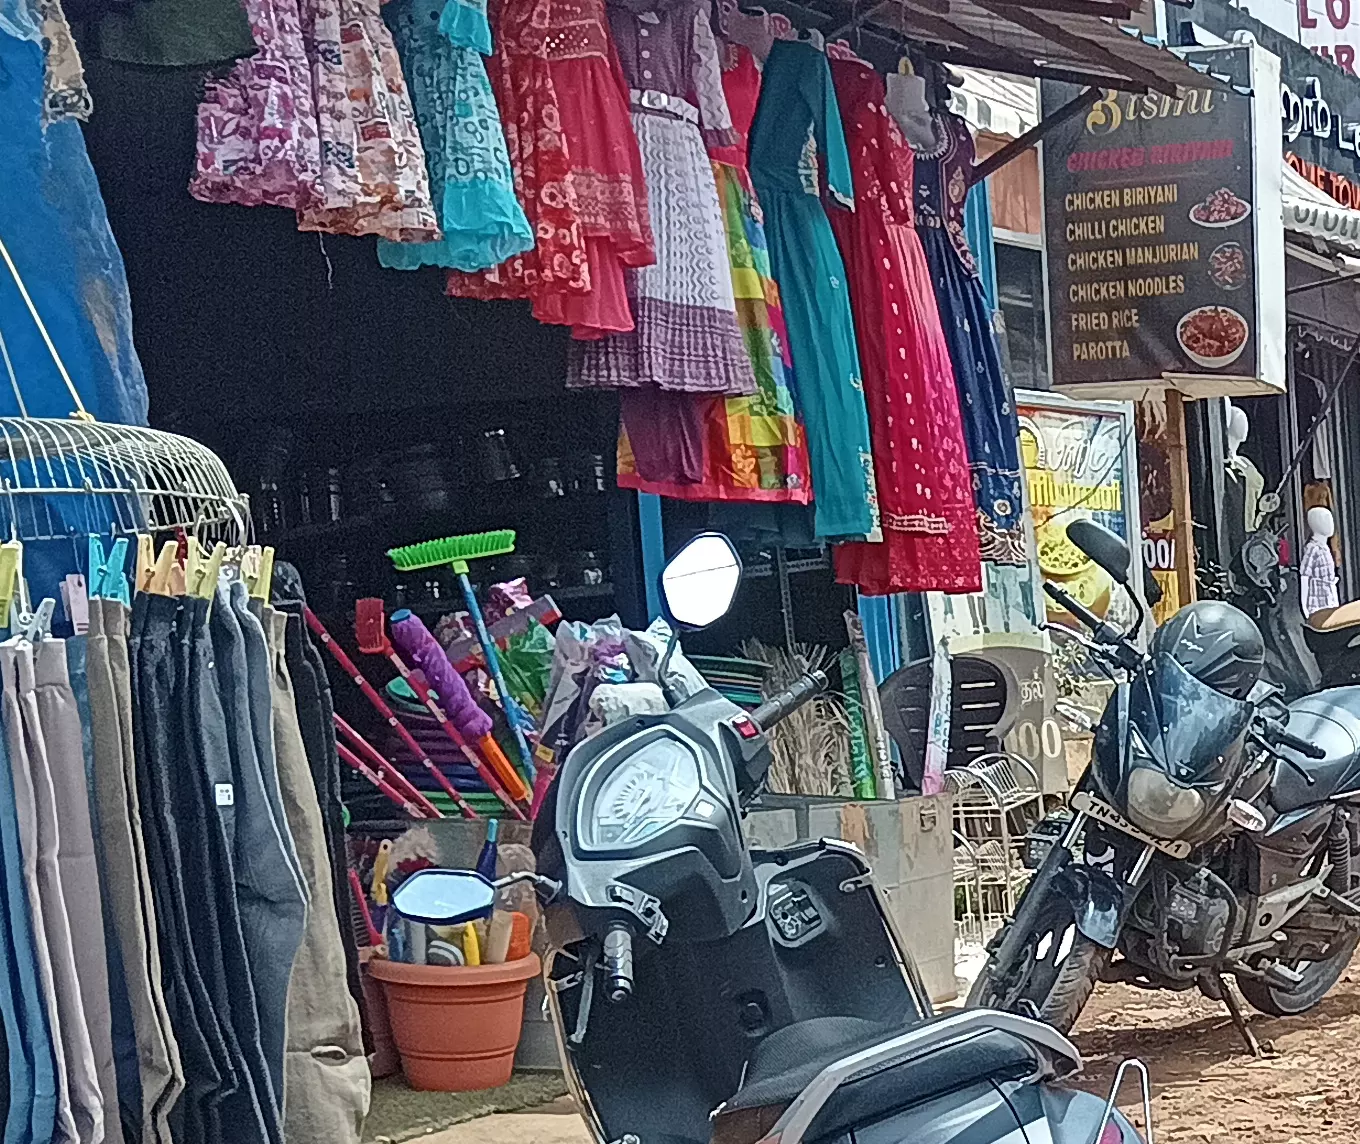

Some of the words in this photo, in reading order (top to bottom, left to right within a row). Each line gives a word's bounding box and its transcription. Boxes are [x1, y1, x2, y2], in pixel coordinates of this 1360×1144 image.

[1065, 188, 1120, 212] CHICKEN
[1123, 184, 1178, 206] BIRIYANI
[1066, 222, 1106, 242] CHILLI
[1109, 215, 1165, 238] CHICKEN
[1067, 248, 1123, 272] CHICKEN
[1126, 242, 1199, 265] MANJURIAN
[1069, 281, 1125, 303] CHICKEN
[1128, 275, 1185, 297] NOODLES
[1071, 311, 1109, 332] FRIED
[1112, 309, 1139, 329] RICE
[1073, 340, 1131, 361] PAROTTA
